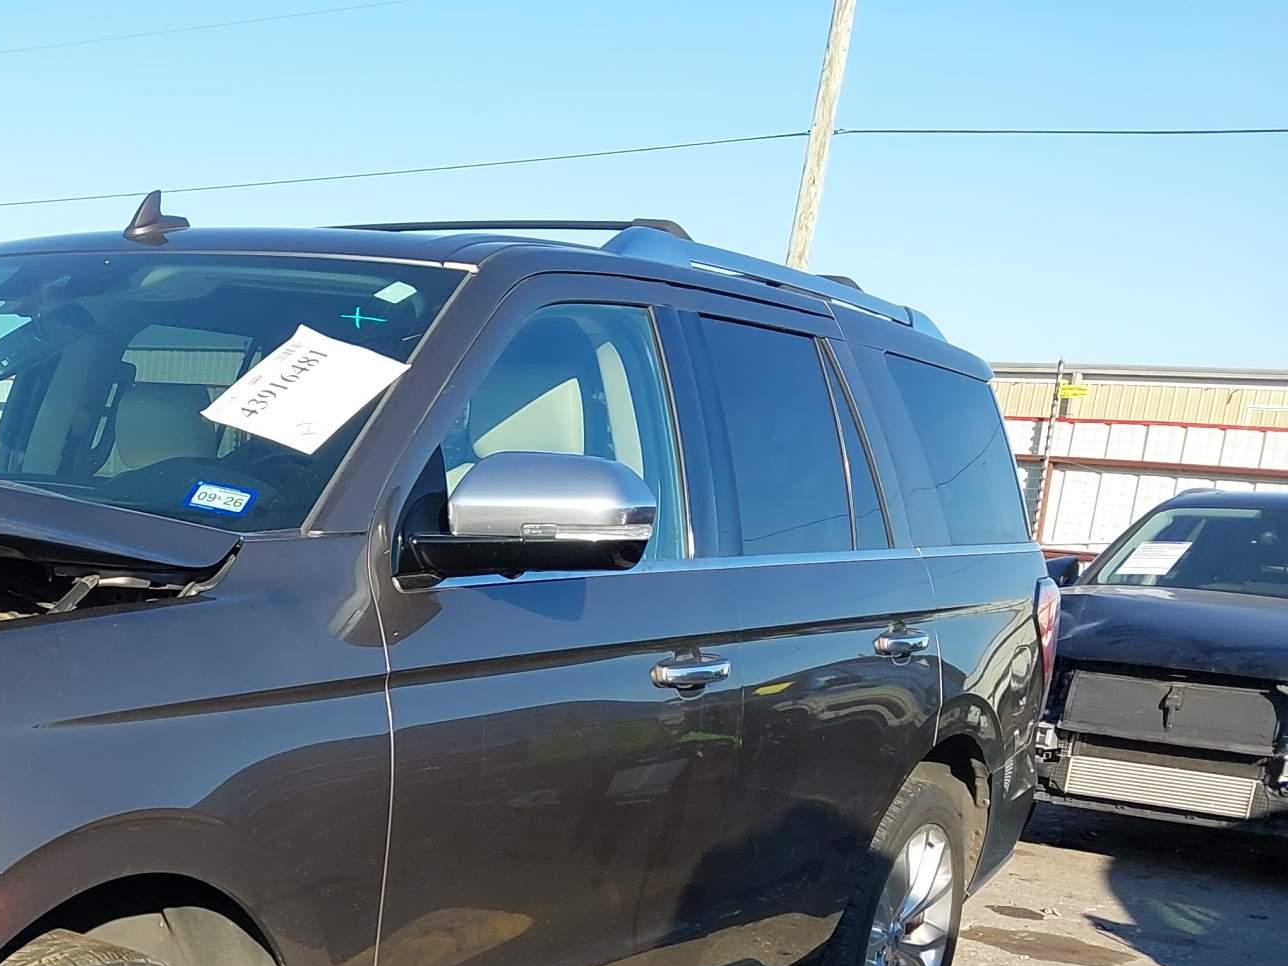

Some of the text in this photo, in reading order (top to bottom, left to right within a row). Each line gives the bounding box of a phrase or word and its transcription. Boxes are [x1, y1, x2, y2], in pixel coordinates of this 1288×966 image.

[240, 350, 328, 418] 43916481
[197, 491, 217, 503] 09
[223, 496, 244, 508] 26
